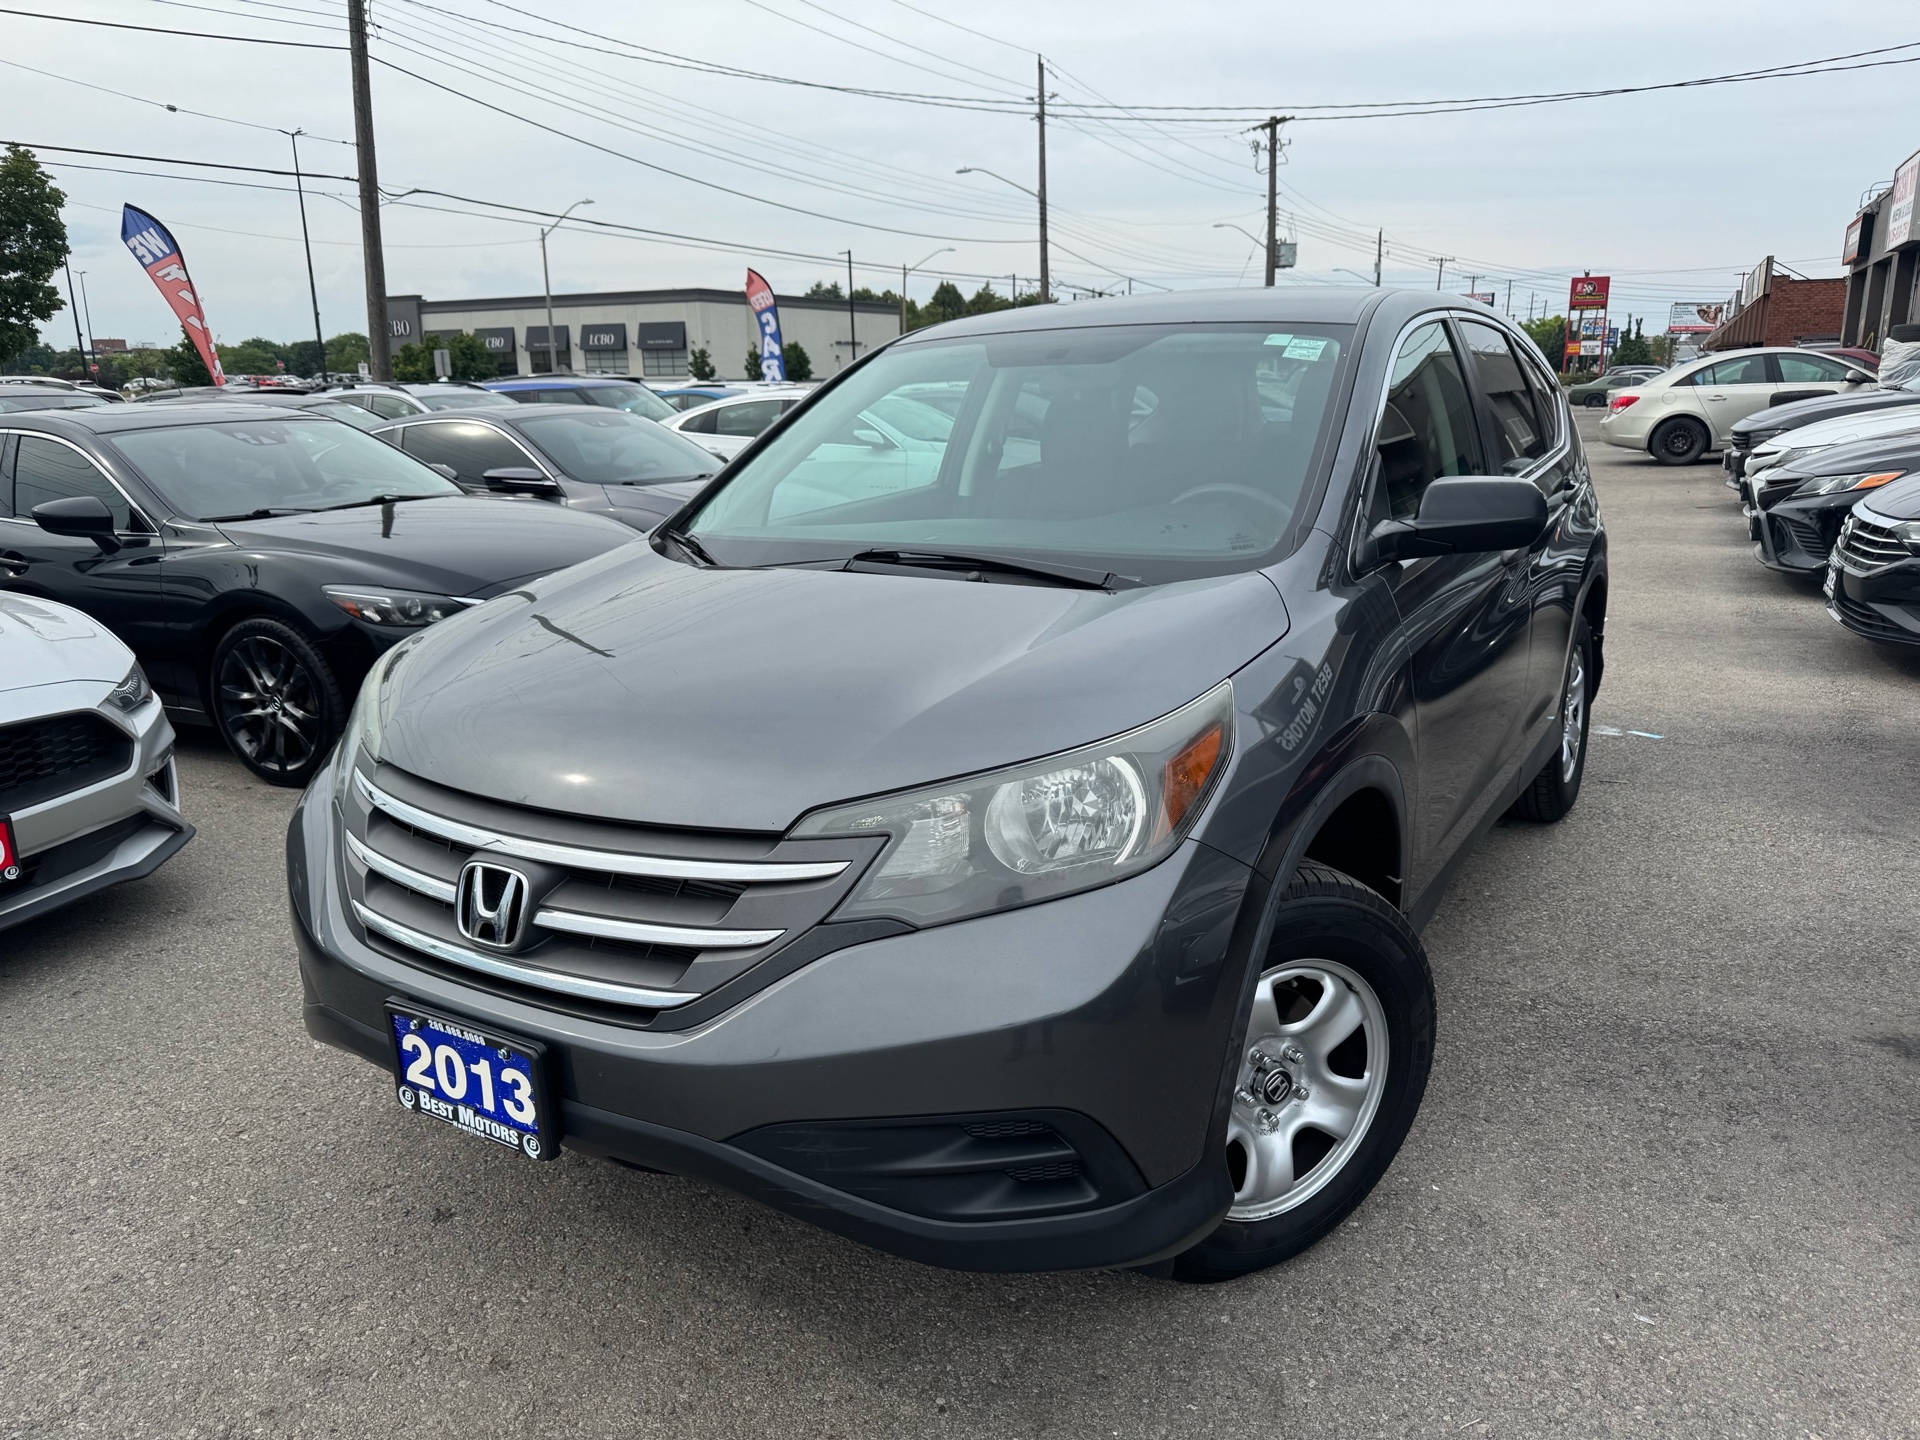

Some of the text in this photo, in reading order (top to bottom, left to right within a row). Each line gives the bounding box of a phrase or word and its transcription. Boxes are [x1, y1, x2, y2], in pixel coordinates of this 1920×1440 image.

[482, 336, 504, 348] CBO
[589, 333, 614, 346] LCBO
[402, 1033, 536, 1126] 2013
[419, 1090, 519, 1145] BEST MOTORS
